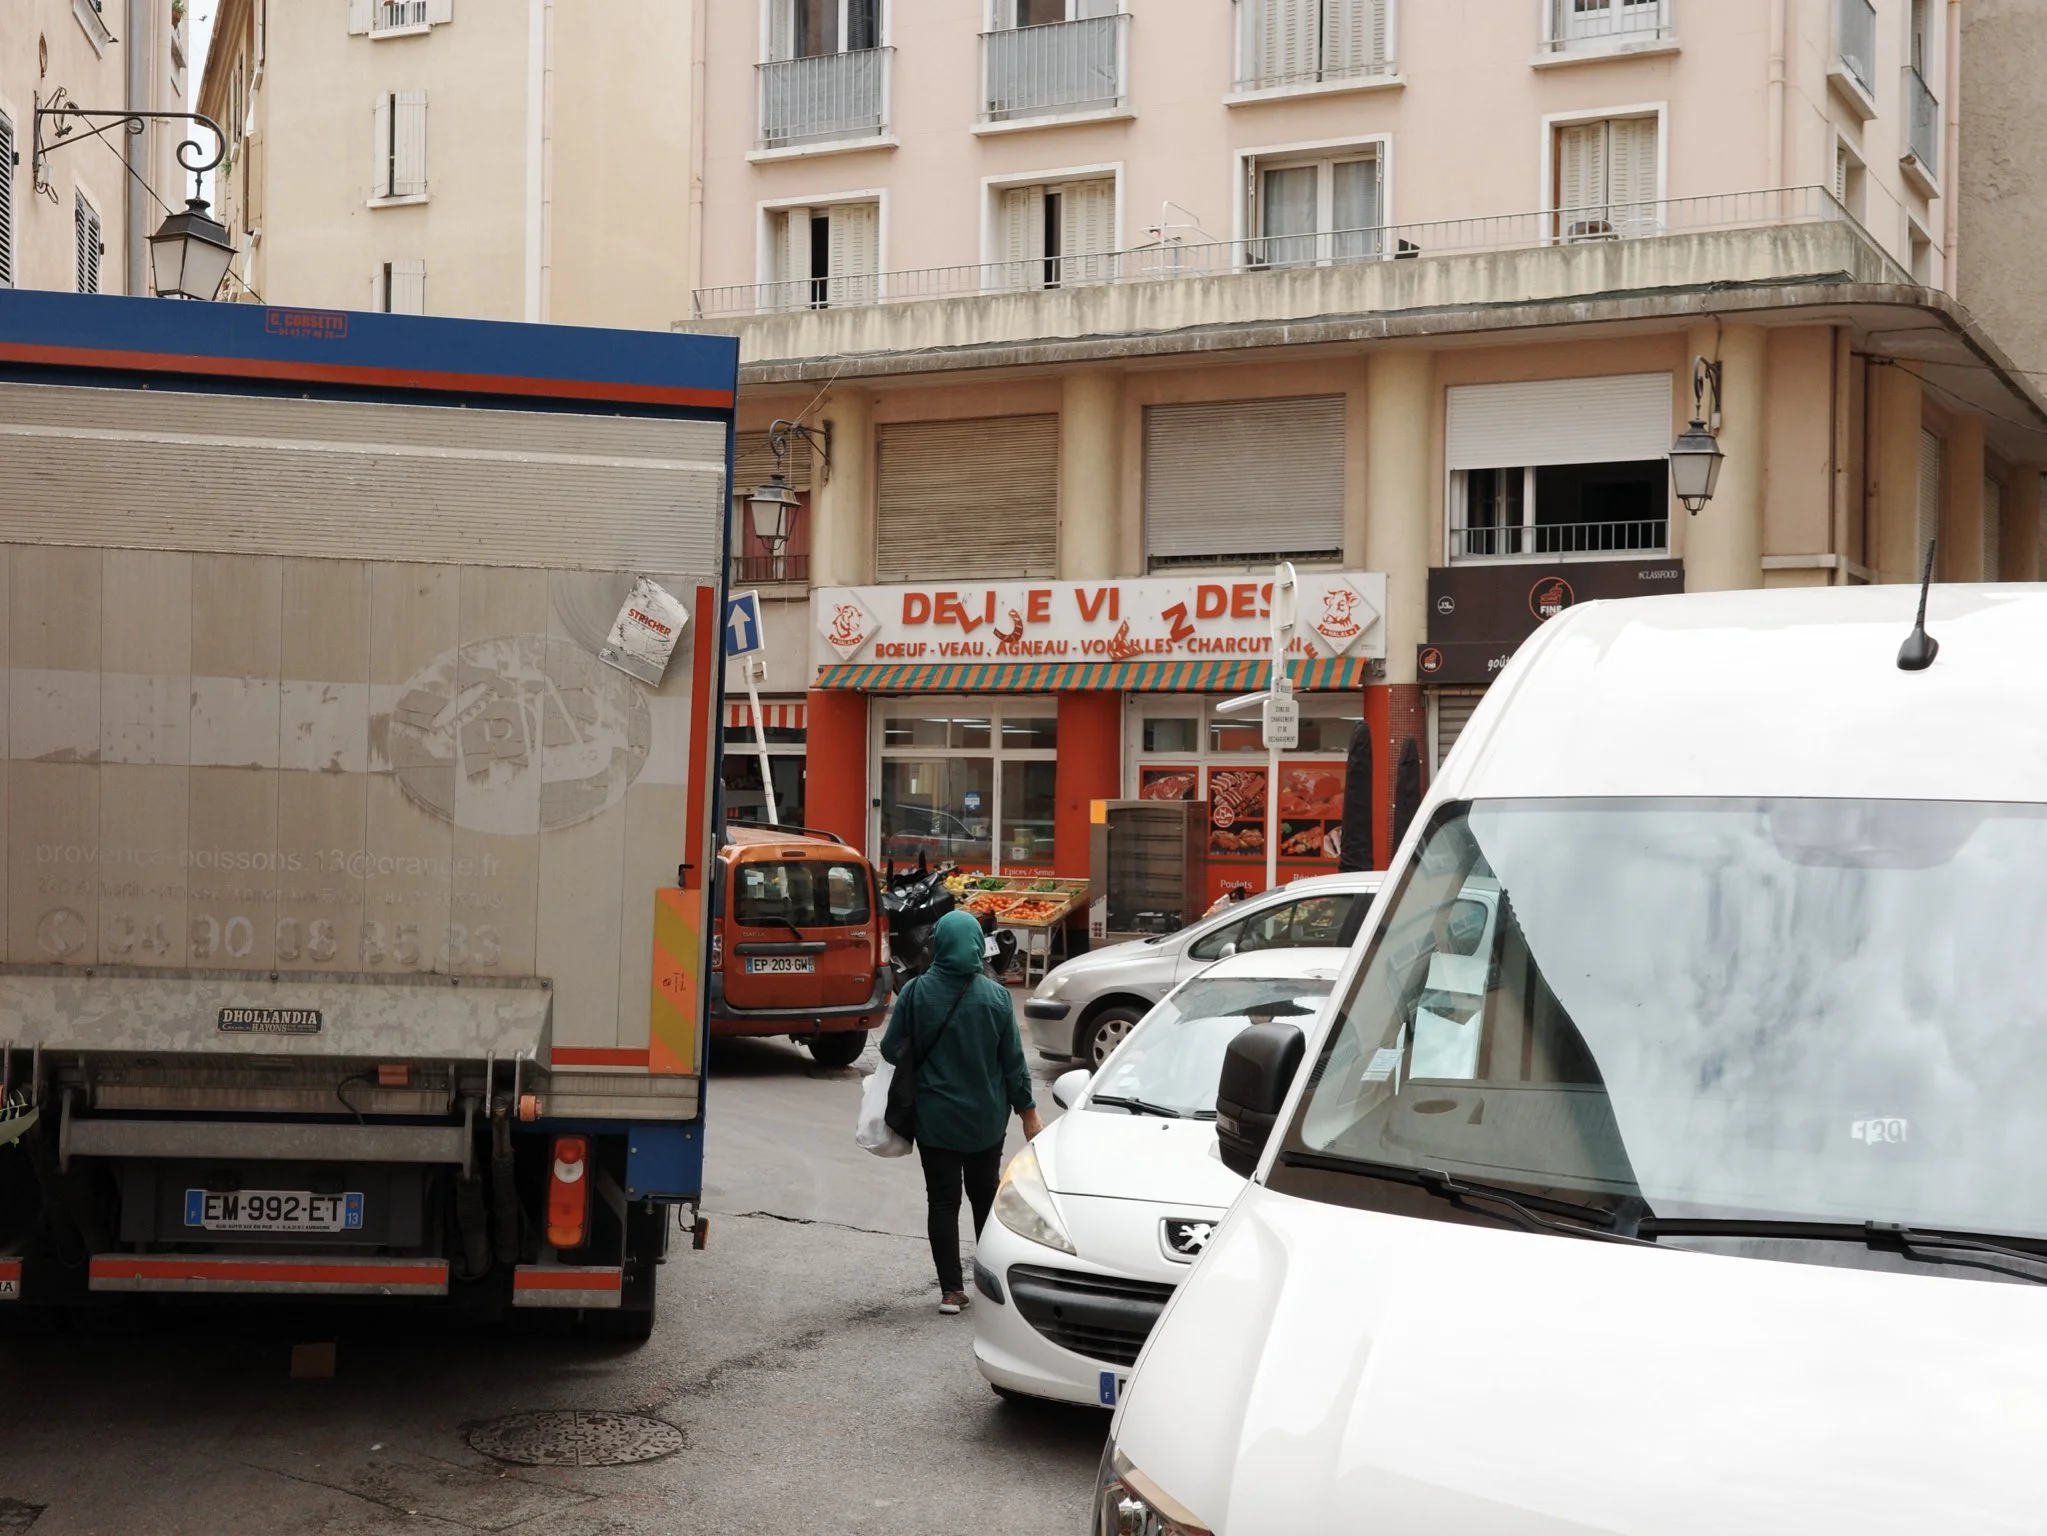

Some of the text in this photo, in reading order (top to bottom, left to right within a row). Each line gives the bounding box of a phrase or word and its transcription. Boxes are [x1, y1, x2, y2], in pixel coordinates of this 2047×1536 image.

[628, 608, 671, 637] STRICHER
[938, 642, 983, 656] VEAU
[996, 640, 1068, 655] AGNEAU
[1220, 879, 1252, 889] Poulets
[190, 914, 254, 959] 90
[222, 1009, 318, 1025] DHOLLANDIA
[251, 1023, 287, 1032] HAYONS
[204, 1195, 343, 1222] EM-992-ET
[347, 1212, 359, 1225] 13
[1105, 1391, 1111, 1400] F
